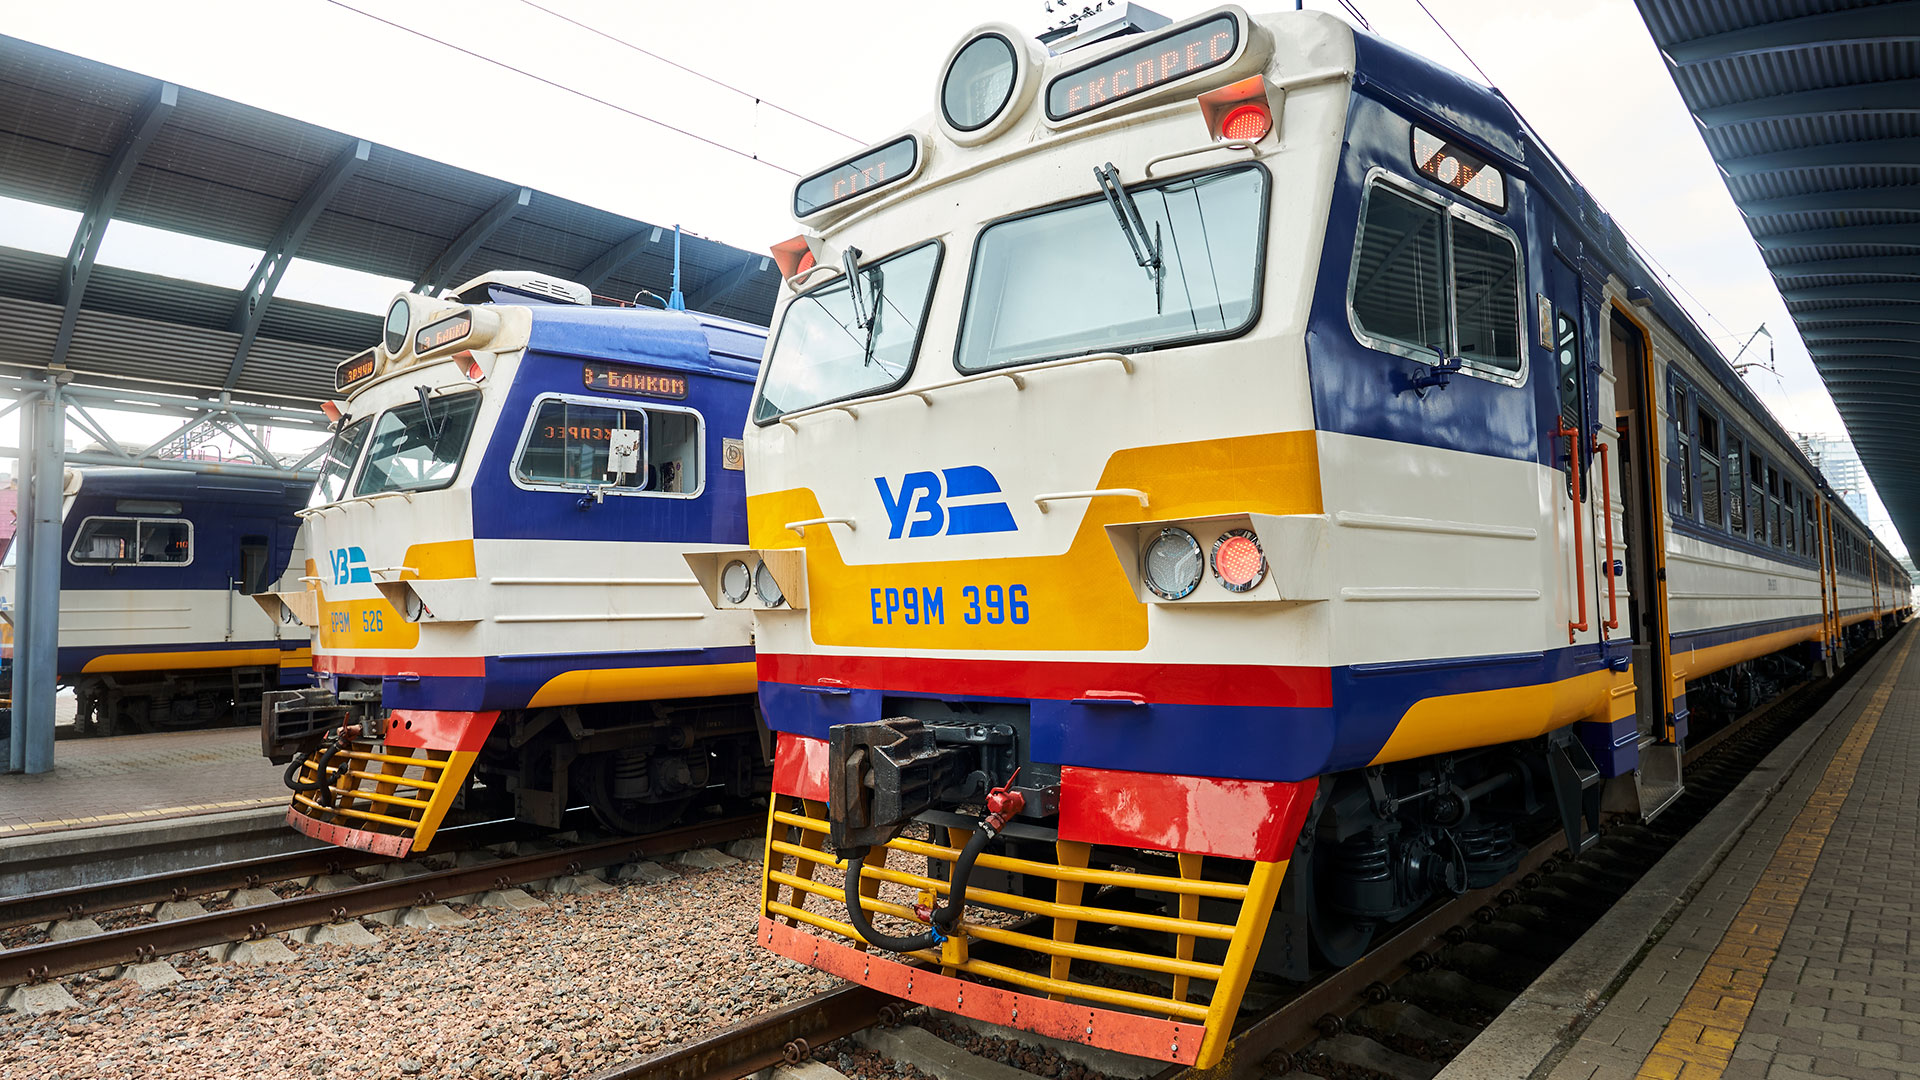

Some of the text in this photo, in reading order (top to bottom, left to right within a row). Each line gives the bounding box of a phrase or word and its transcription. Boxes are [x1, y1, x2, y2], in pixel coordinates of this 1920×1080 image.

[1069, 31, 1229, 112] ЕКСПРЕС
[1414, 139, 1496, 203] КСПРЕС
[608, 371, 684, 394] БАЙКОМ
[331, 610, 383, 633] ЕР9М 526
[870, 584, 1030, 625] ЕР9М 396
